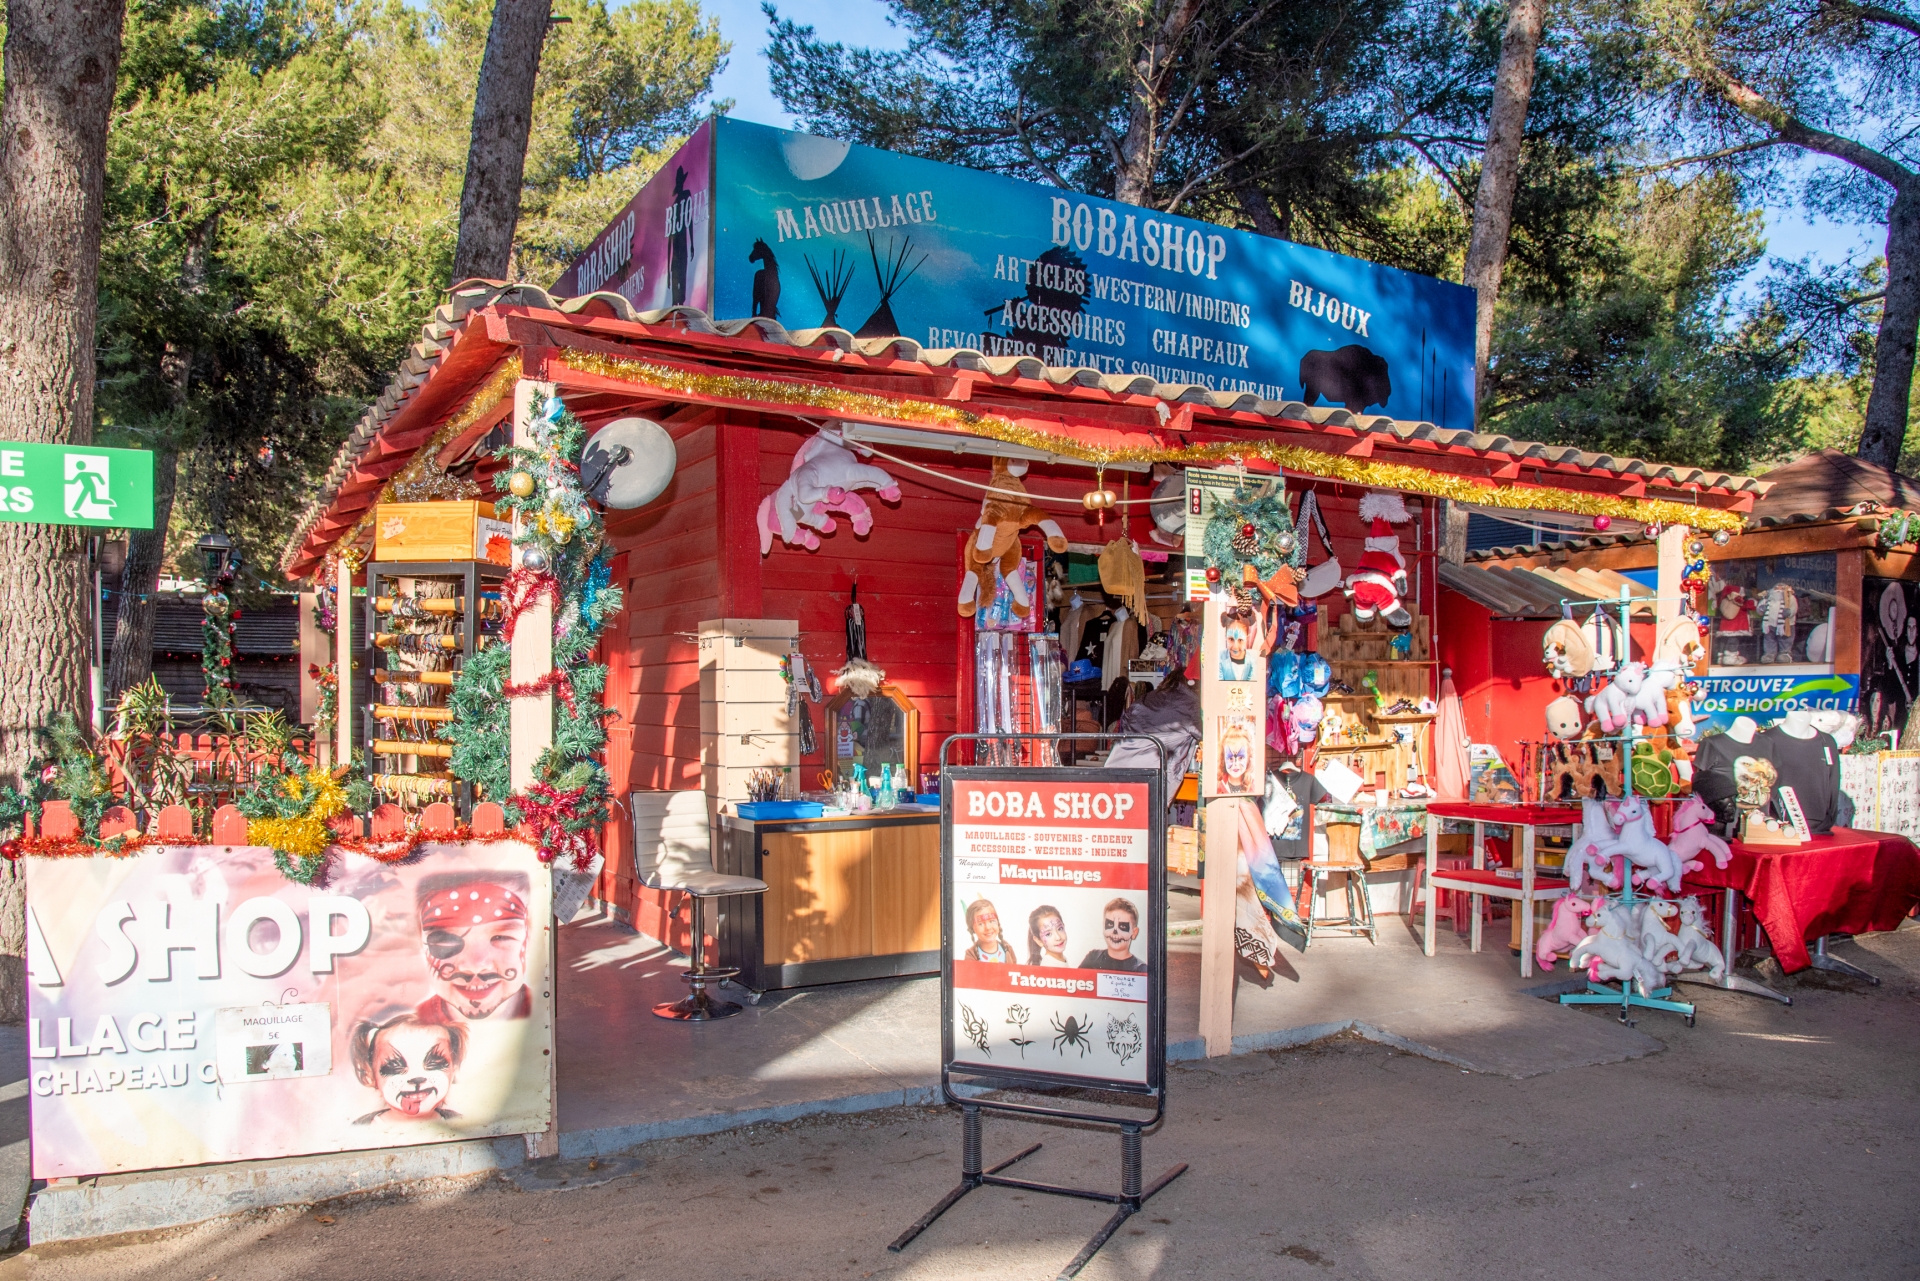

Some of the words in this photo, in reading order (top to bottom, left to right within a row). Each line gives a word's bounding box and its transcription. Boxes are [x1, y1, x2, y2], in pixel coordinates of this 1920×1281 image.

[775, 190, 937, 242] MAQUILLAGE
[1050, 196, 1226, 281] BOBASHOP
[994, 254, 1086, 296] ARTICLES
[1092, 273, 1250, 329] WESTERN/INDIENS
[1000, 299, 1126, 347] ACCESSOIRES
[1288, 279, 1372, 338] BIJOUX
[1152, 328, 1249, 369] CHAPEAUX
[1693, 699, 1728, 712] VOS
[1734, 699, 1808, 712] PHOTOS
[1815, 698, 1839, 711] ICI
[968, 790, 1045, 819] BOBA
[1053, 792, 1134, 820] SHOP
[965, 831, 1026, 841] MAQUILLAGES
[1034, 833, 1083, 843] SOUVENIRS
[1091, 834, 1133, 844] CADEAUX
[970, 844, 1026, 854] ACCESSOIRES
[1034, 846, 1083, 856] WESTERNS
[1091, 848, 1128, 858] INDIENS
[959, 859, 993, 868] Maquillage
[1001, 864, 1102, 884] Maquillages
[94, 896, 372, 988] SHOP
[1008, 971, 1095, 993] Tatouages
[243, 1014, 304, 1026] MAQUILLAGE
[268, 1031, 280, 1040] 5€
[32, 1063, 189, 1096] CHAPEAU
